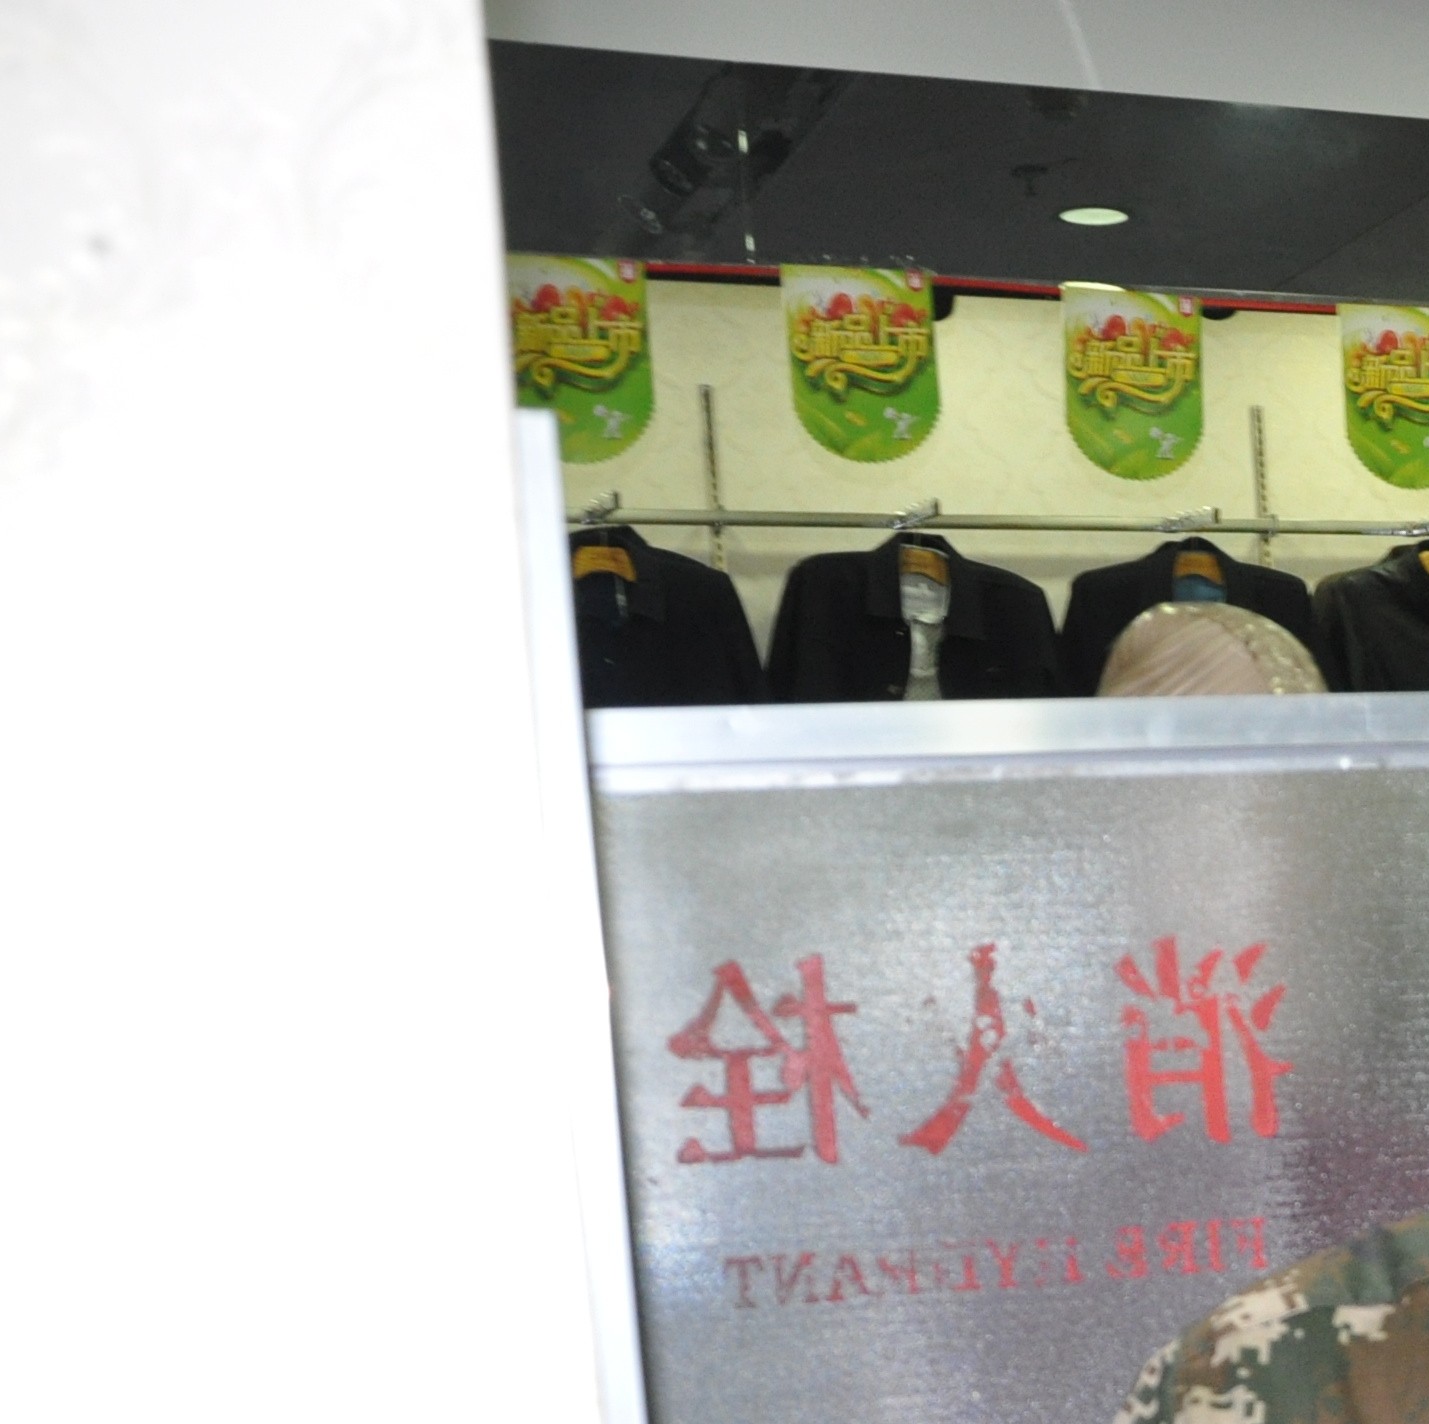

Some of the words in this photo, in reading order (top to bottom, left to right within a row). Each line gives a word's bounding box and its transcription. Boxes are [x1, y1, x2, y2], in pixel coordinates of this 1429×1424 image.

[797, 313, 929, 372] 新品上市
[1074, 335, 1196, 392] 新品上市
